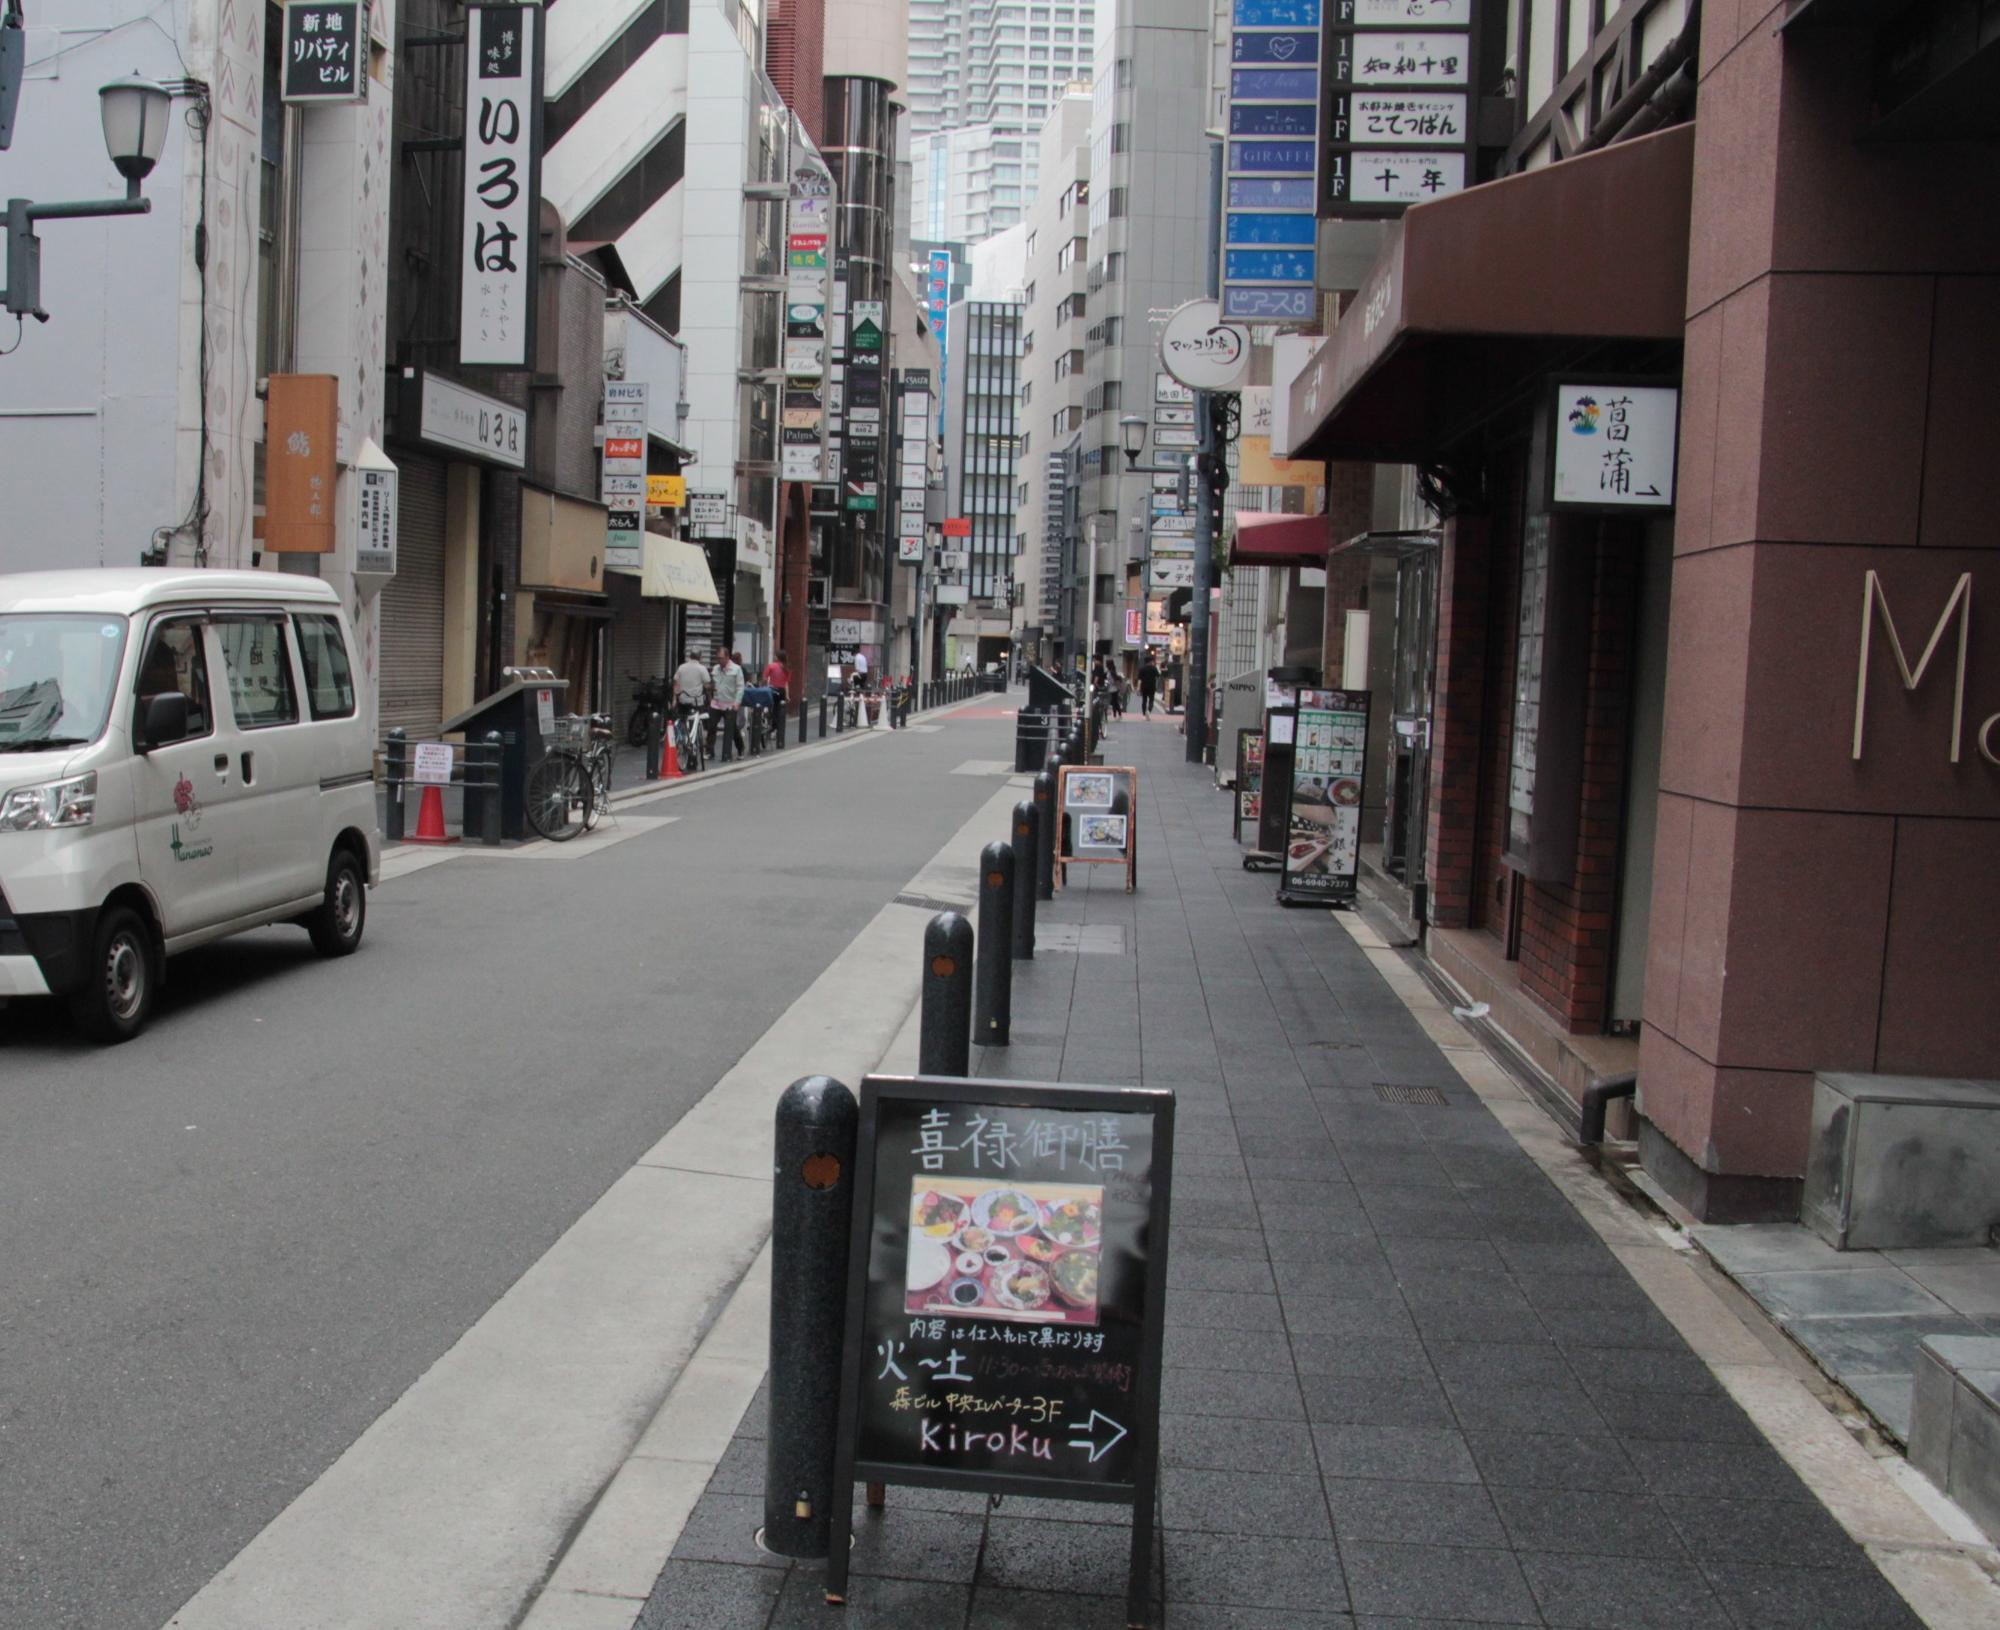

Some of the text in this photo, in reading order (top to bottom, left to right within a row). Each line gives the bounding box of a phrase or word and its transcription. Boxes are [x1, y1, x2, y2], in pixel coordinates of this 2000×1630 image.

[303, 12, 343, 33] 新地
[294, 37, 349, 63] リバティ
[501, 30, 515, 60] 博多
[319, 65, 350, 83] ビル
[474, 96, 520, 273] いろは
[1374, 168, 1446, 193] 十年
[1229, 291, 1307, 314] ピアース8
[479, 407, 519, 453] いろは
[786, 430, 814, 440] Palms
[1600, 396, 1633, 494] 菖蒲
[1229, 683, 1256, 692] NIPPO
[911, 1108, 1130, 1172] 喜禄御膳
[909, 1318, 1105, 1352] 内容は仕入れにて異なります
